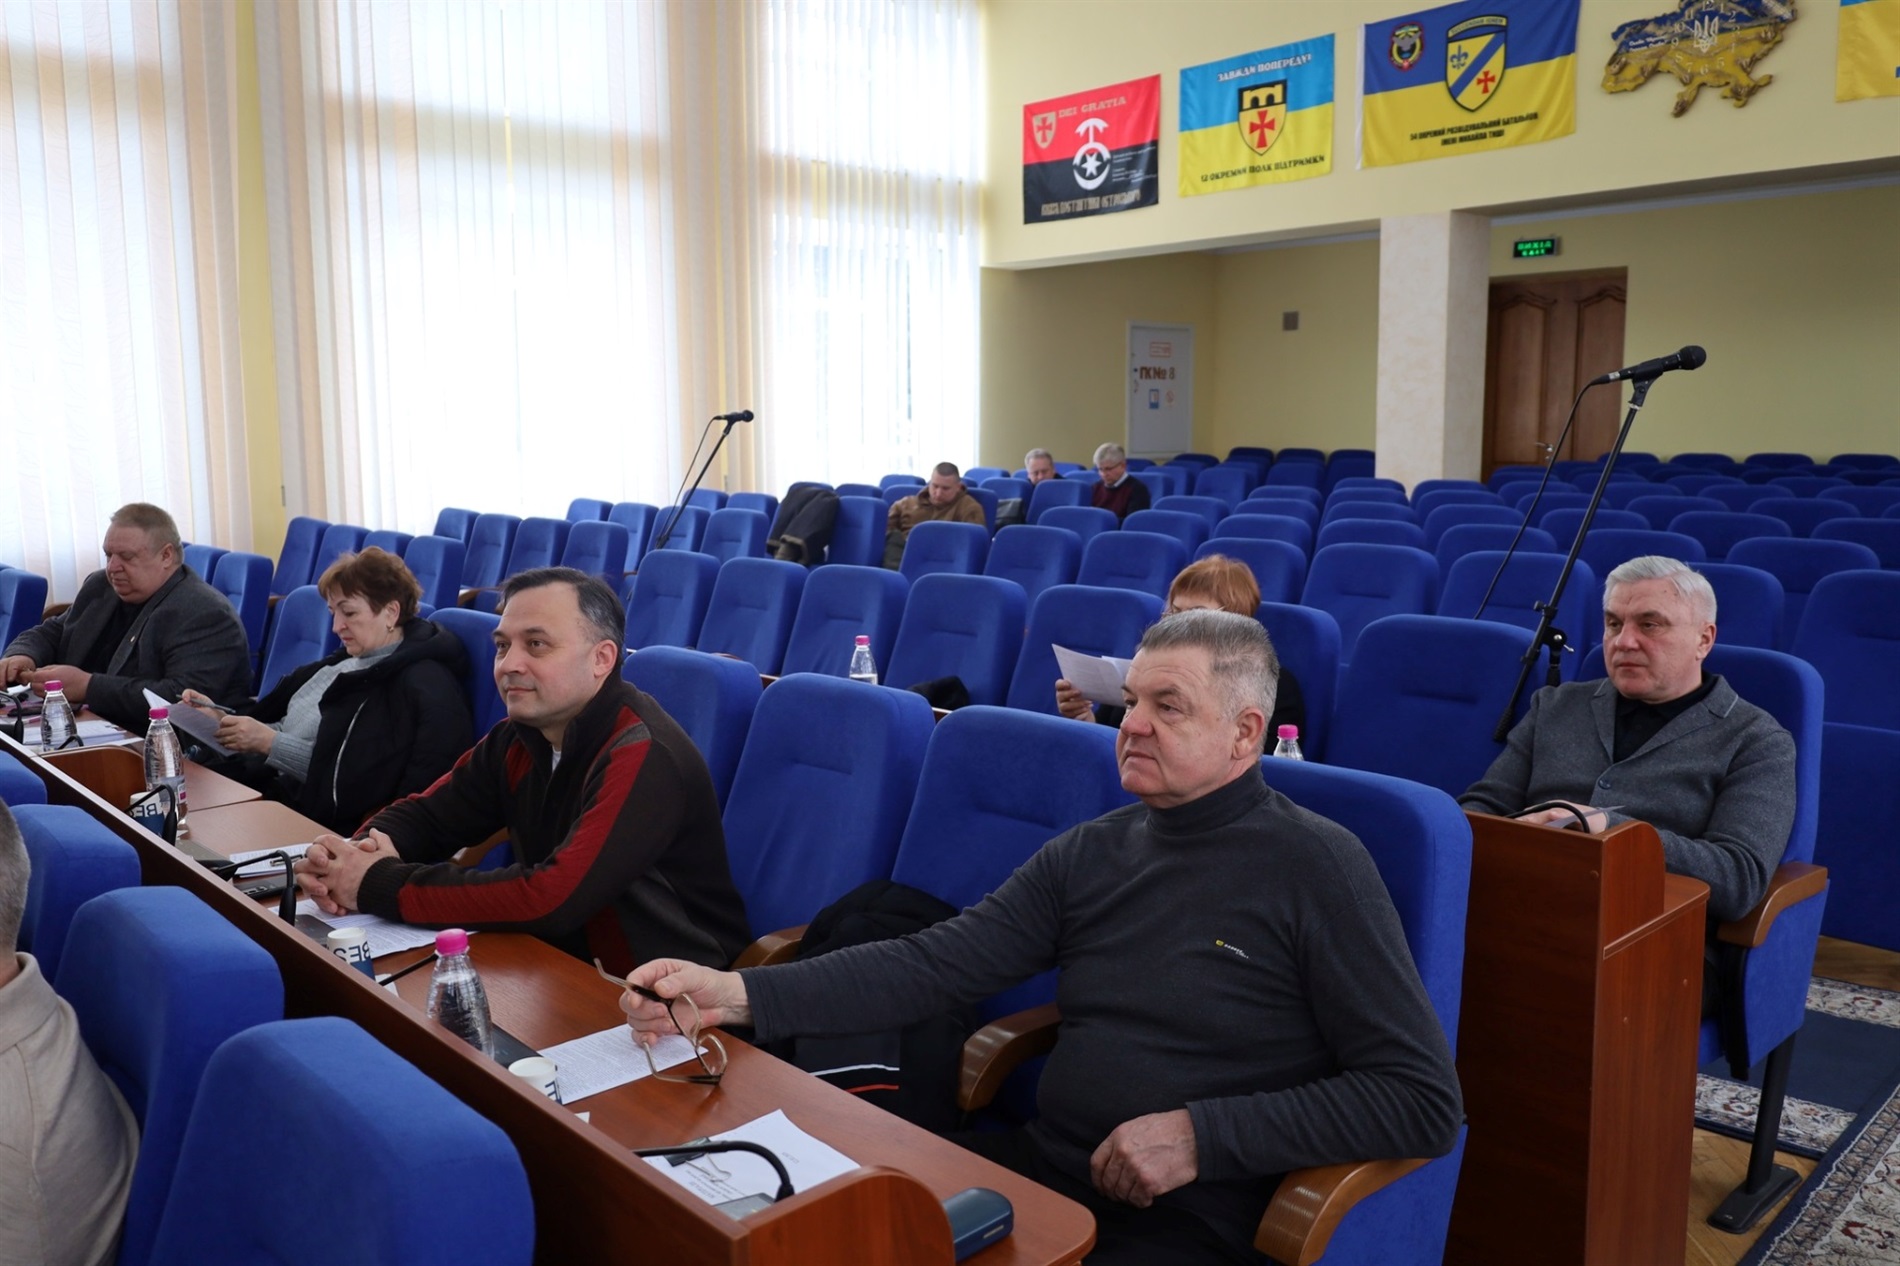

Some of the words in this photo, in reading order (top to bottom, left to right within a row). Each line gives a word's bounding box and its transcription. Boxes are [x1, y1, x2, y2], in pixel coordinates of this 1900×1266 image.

[1217, 64, 1256, 82] ЗАВЖДИ
[1058, 106, 1077, 118] DEI
[1081, 96, 1127, 113] GRATIA
[1248, 162, 1272, 174] ПОЛК
